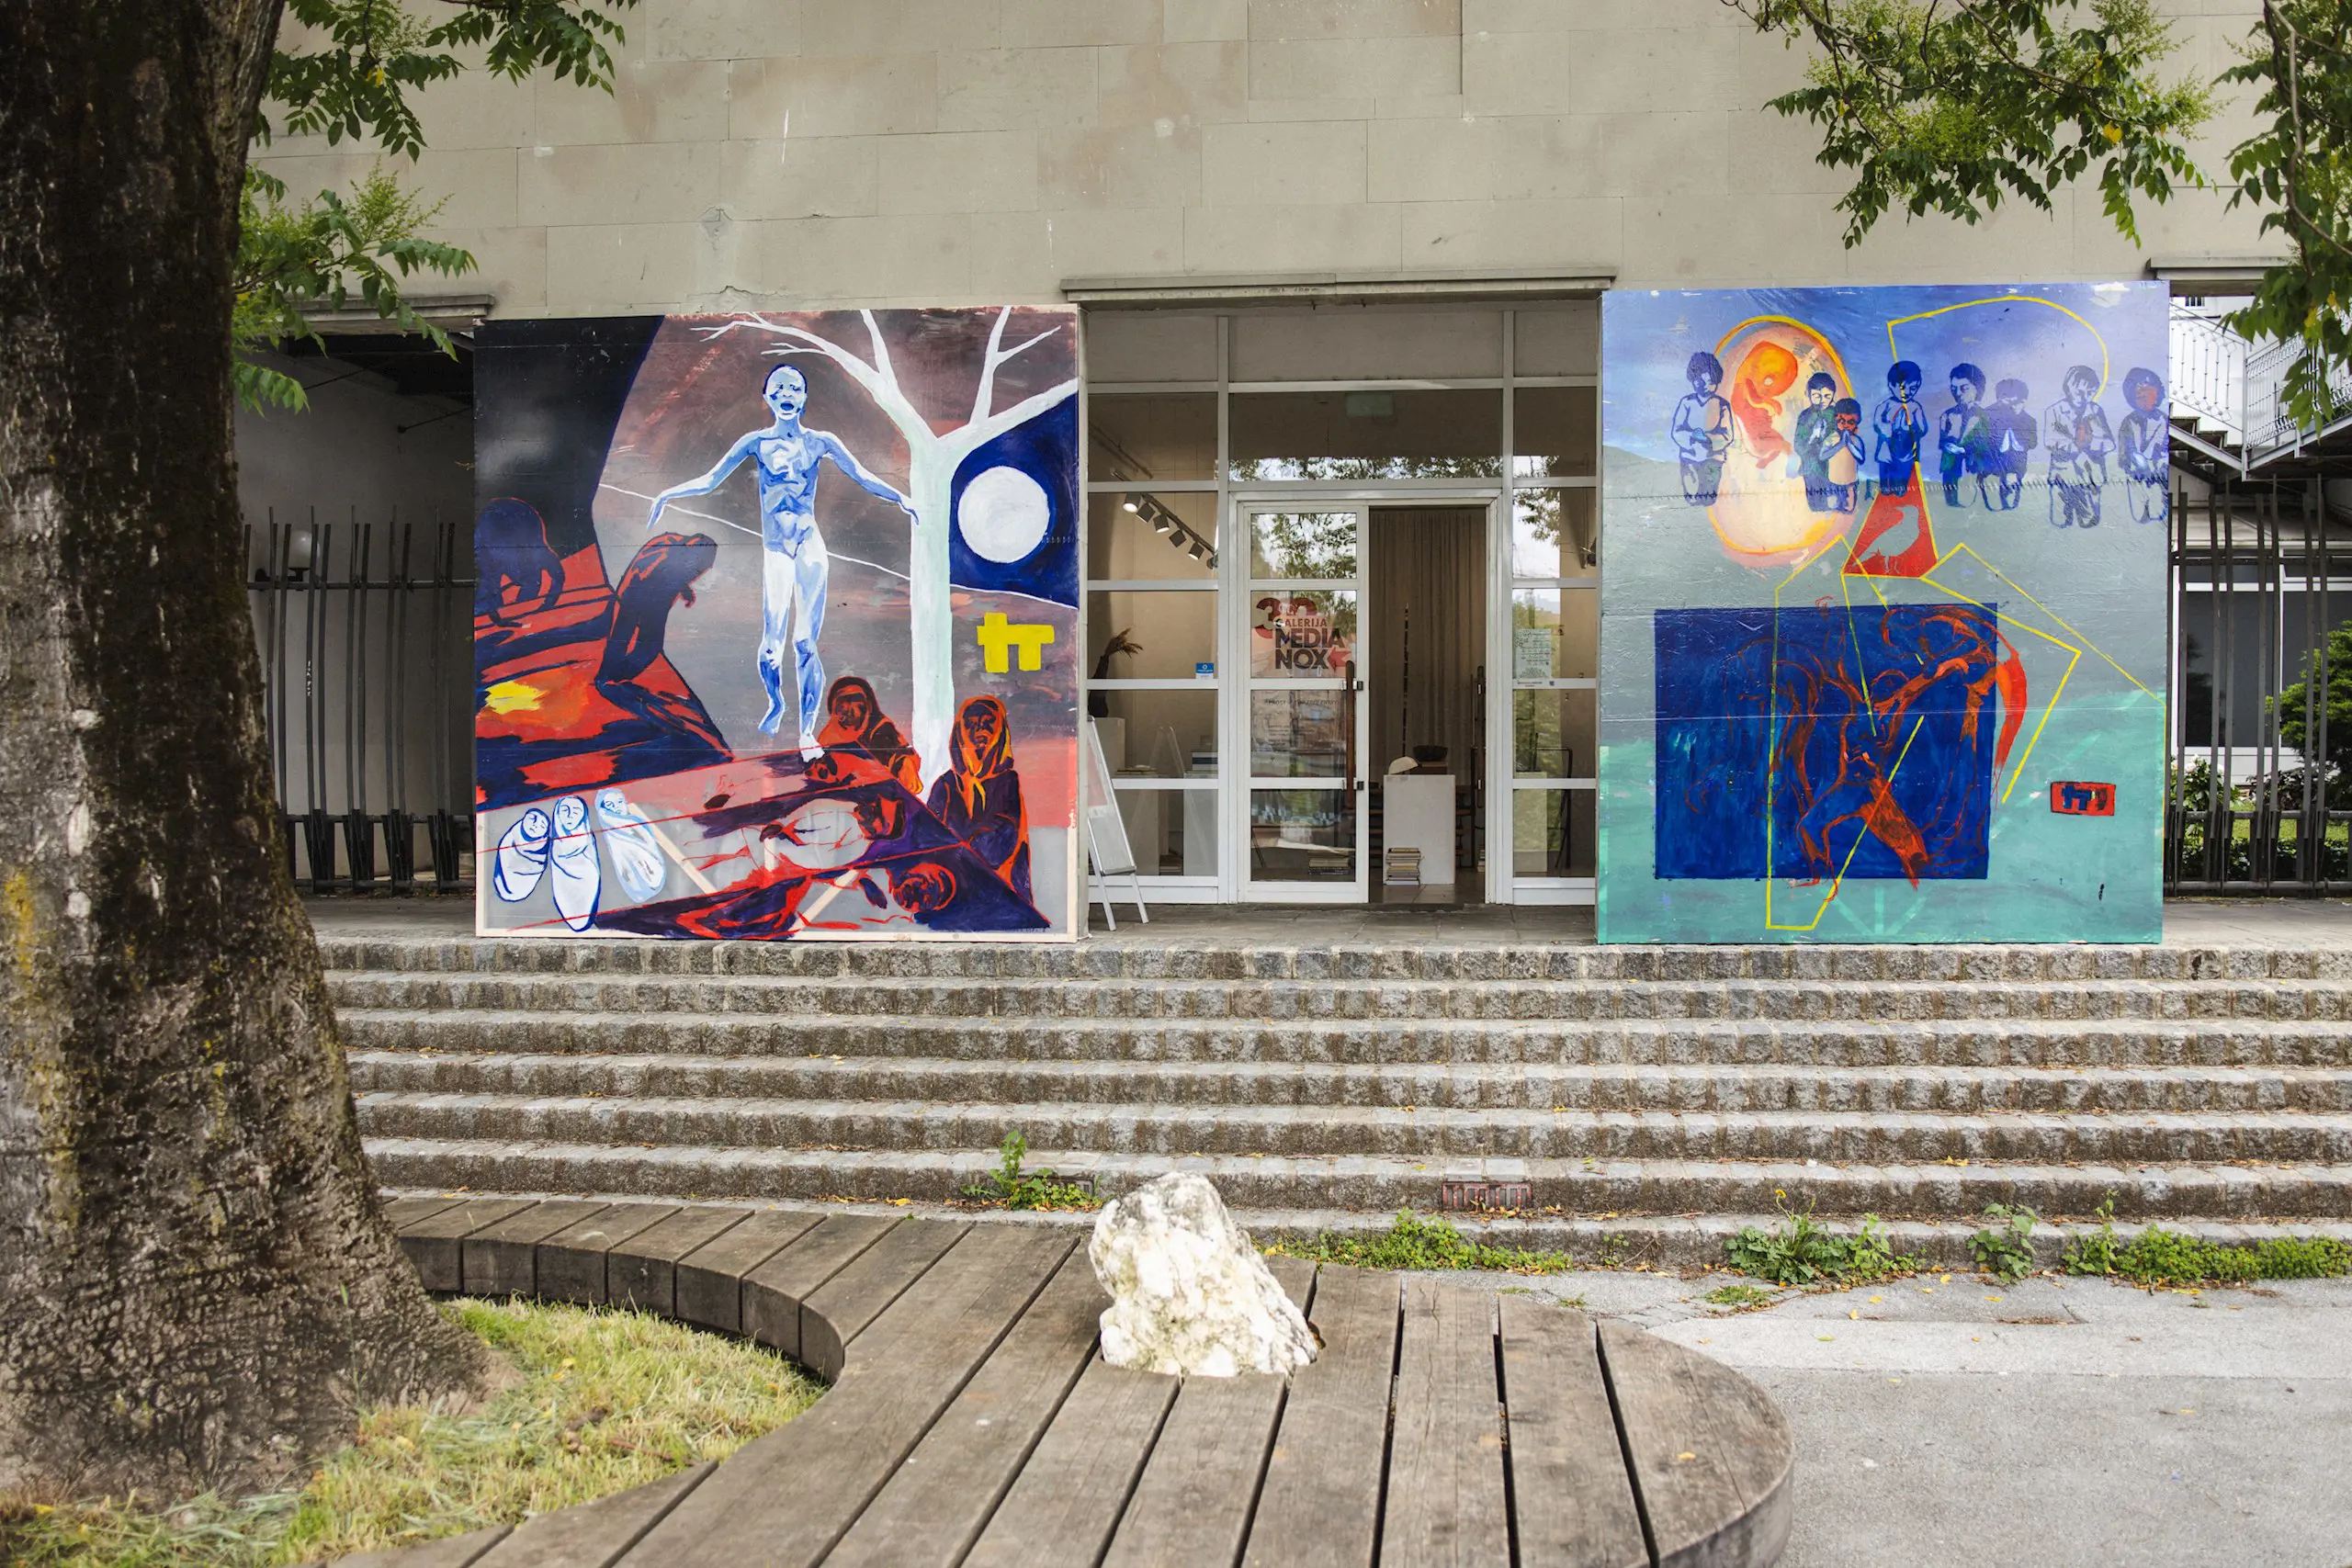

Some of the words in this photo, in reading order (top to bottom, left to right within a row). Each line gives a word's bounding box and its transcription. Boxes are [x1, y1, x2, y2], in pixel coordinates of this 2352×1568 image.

[1275, 618, 1328, 627] GALERIJA
[1275, 628, 1345, 649] MEDIA
[1275, 649, 1329, 670] NOX
